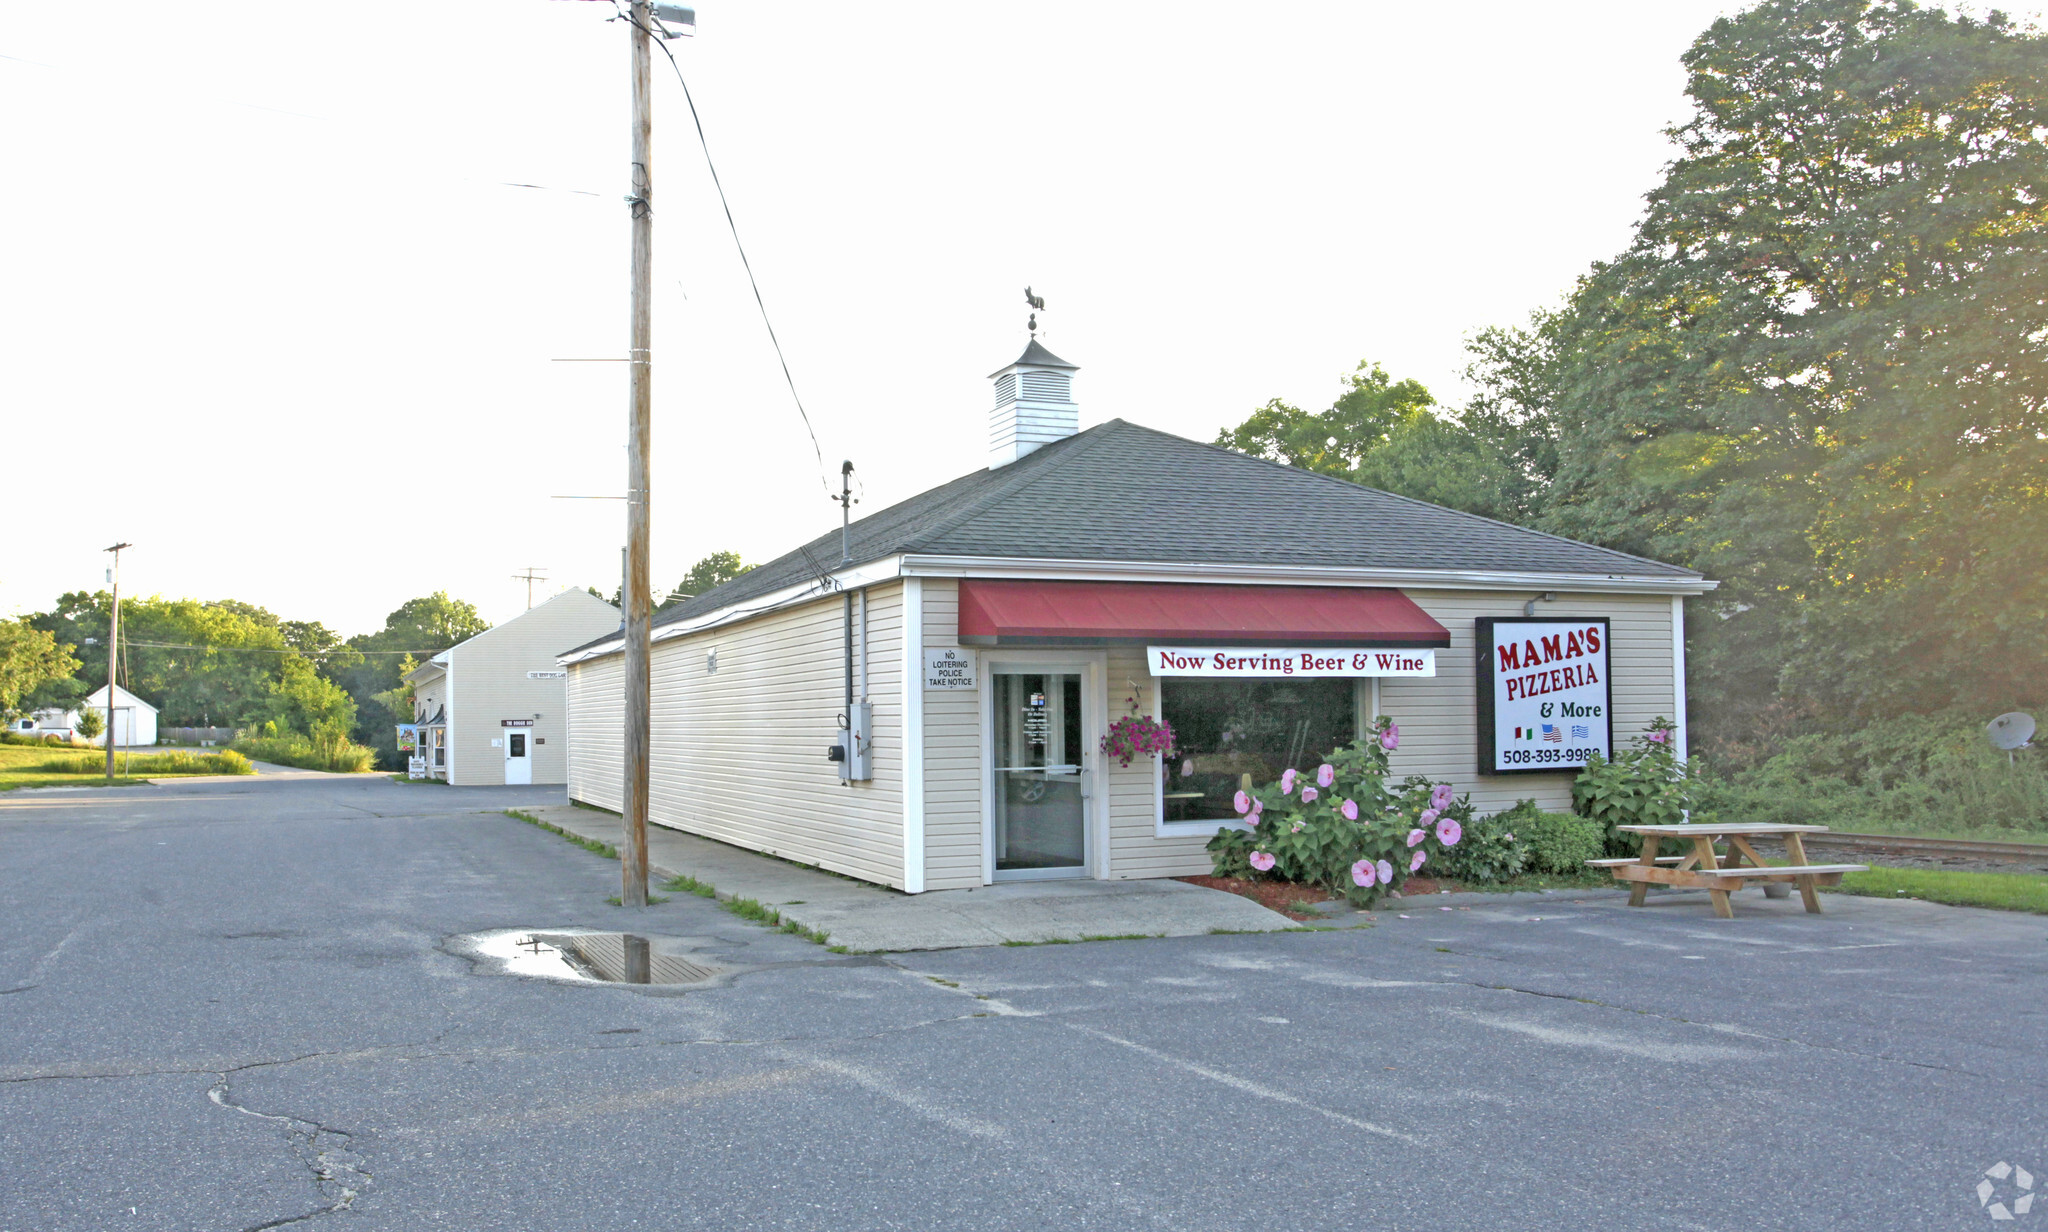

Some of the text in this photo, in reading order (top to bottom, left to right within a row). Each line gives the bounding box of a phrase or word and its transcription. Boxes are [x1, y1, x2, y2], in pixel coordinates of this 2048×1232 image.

[945, 652, 956, 660] NO
[1497, 627, 1601, 673] MAMA'S
[932, 660, 968, 669] LOITERING
[1160, 651, 1424, 674] Now Serving Beer & Wine
[938, 669, 963, 677] POLICE
[929, 678, 972, 686] TAKE NOTICE
[1505, 662, 1599, 702] PIZZERIA
[1540, 702, 1602, 718] & More
